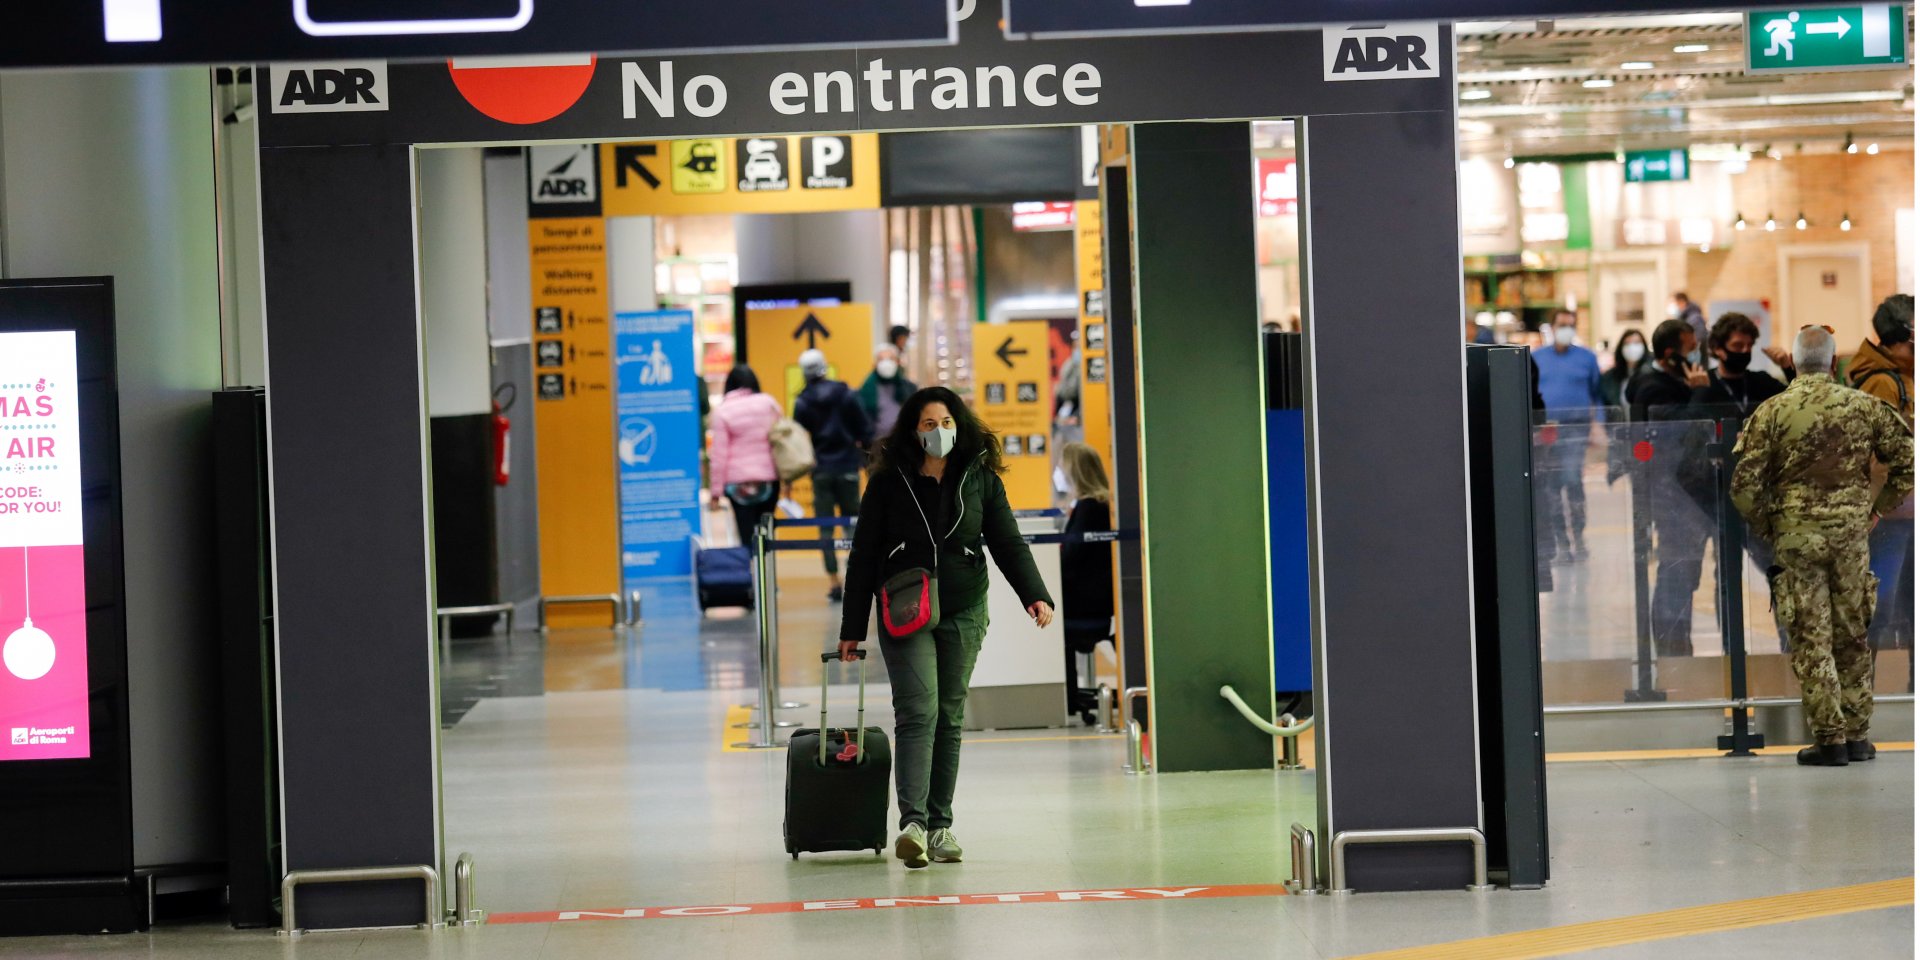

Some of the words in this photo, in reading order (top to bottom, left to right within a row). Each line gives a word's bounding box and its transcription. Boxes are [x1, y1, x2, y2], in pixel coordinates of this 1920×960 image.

[1332, 35, 1431, 73] ADR
[280, 68, 380, 105] ADR
[621, 60, 727, 119] No
[769, 58, 1101, 115] entrance
[538, 178, 586, 196] ADR
[545, 268, 593, 281] Walking
[543, 285, 597, 296] distances
[6, 436, 55, 458] AIR
[24, 501, 61, 513] YOU!
[29, 726, 75, 737] Aeroporti
[29, 735, 39, 744] di
[40, 735, 67, 744] Roma
[558, 906, 752, 920] NO
[803, 888, 1210, 910] ENTRY
